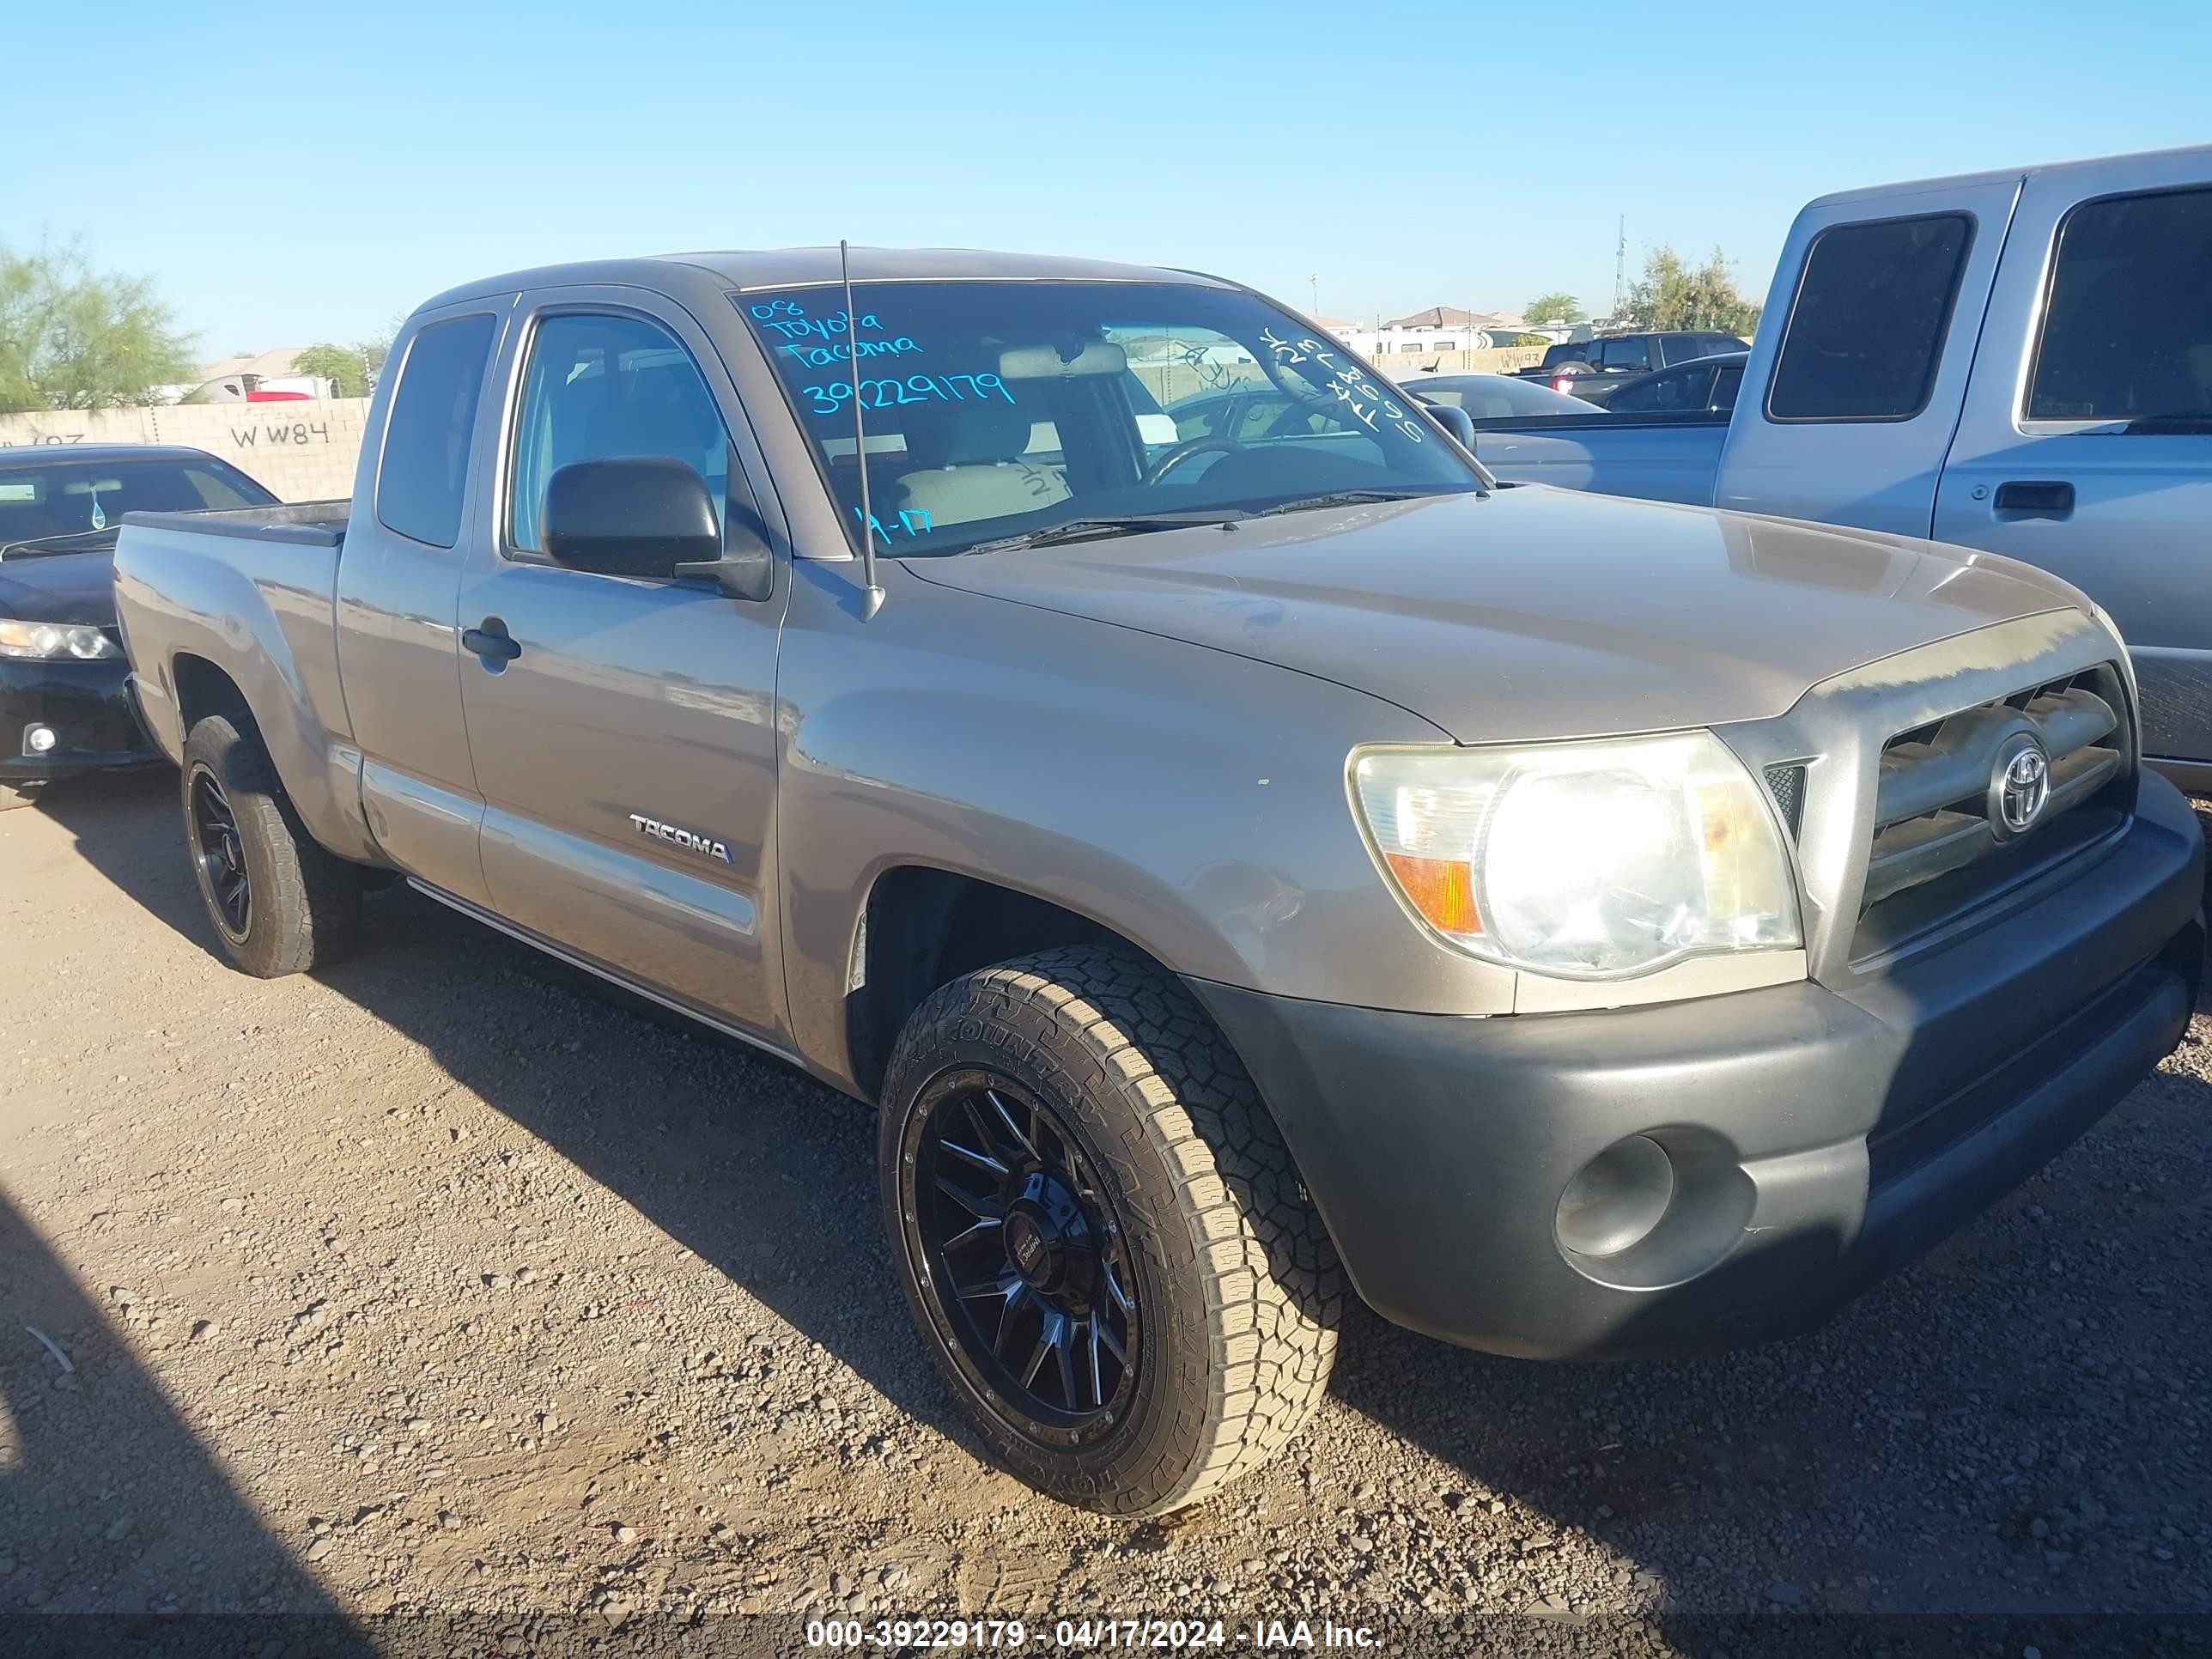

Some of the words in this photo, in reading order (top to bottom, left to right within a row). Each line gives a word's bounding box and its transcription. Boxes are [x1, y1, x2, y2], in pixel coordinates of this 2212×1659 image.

[776, 337, 924, 369] Tacoma
[803, 374, 1016, 415] 39229179
[629, 813, 734, 866] TACOMA
[944, 1016, 1108, 1135] COUNTRY
[1018, 1236, 1042, 1268] IMPACT
